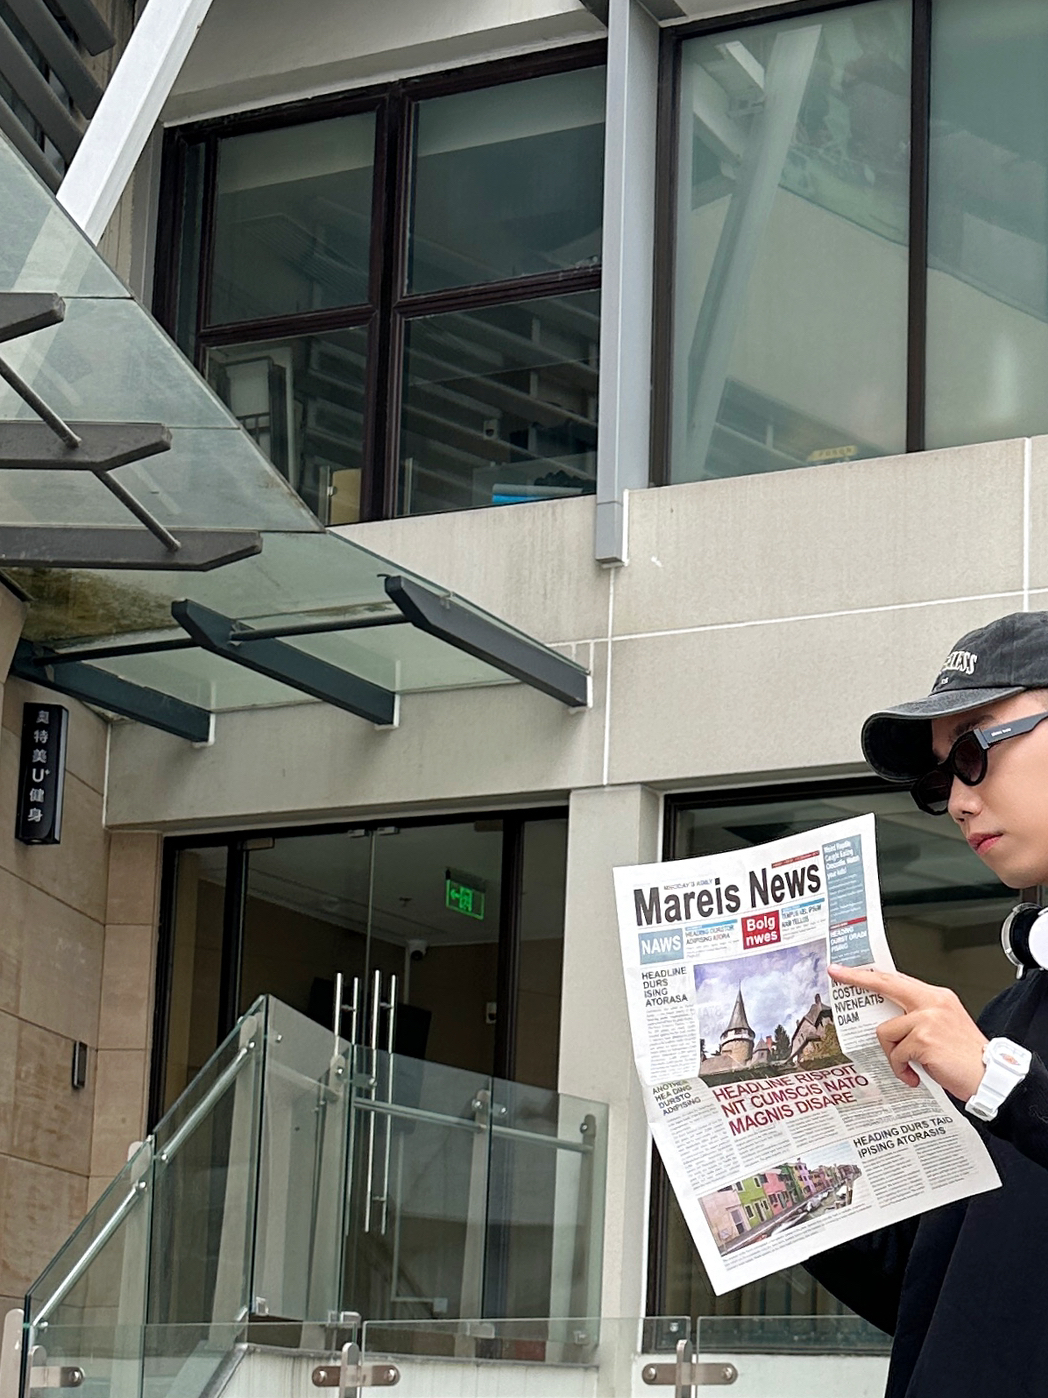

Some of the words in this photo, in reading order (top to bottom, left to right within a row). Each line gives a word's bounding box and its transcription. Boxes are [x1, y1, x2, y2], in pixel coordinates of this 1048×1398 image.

[633, 877, 741, 927] Mareis
[748, 863, 821, 909] News
[746, 915, 776, 932] Bolg
[640, 934, 682, 956] NAWS
[745, 930, 778, 947] nwes
[641, 966, 687, 980] HEADLINE
[643, 979, 669, 990] DURS
[644, 988, 668, 998] ISING
[645, 994, 688, 1007] ATORASA
[834, 993, 884, 1013] NVENEATIS
[837, 1011, 860, 1026] DIAM
[712, 1076, 794, 1103] HEADLINE
[794, 1064, 857, 1084] RISPOIT
[720, 1098, 748, 1118] NIT
[750, 1083, 823, 1109] CUMSCIS
[823, 1075, 869, 1092] NATO
[728, 1104, 794, 1136] MAGNIS
[795, 1091, 857, 1114] DISARE
[853, 1126, 899, 1148] HEADING
[900, 1120, 929, 1134] DURS
[858, 1140, 895, 1158] IPISING
[897, 1126, 946, 1147] ATORASIS
